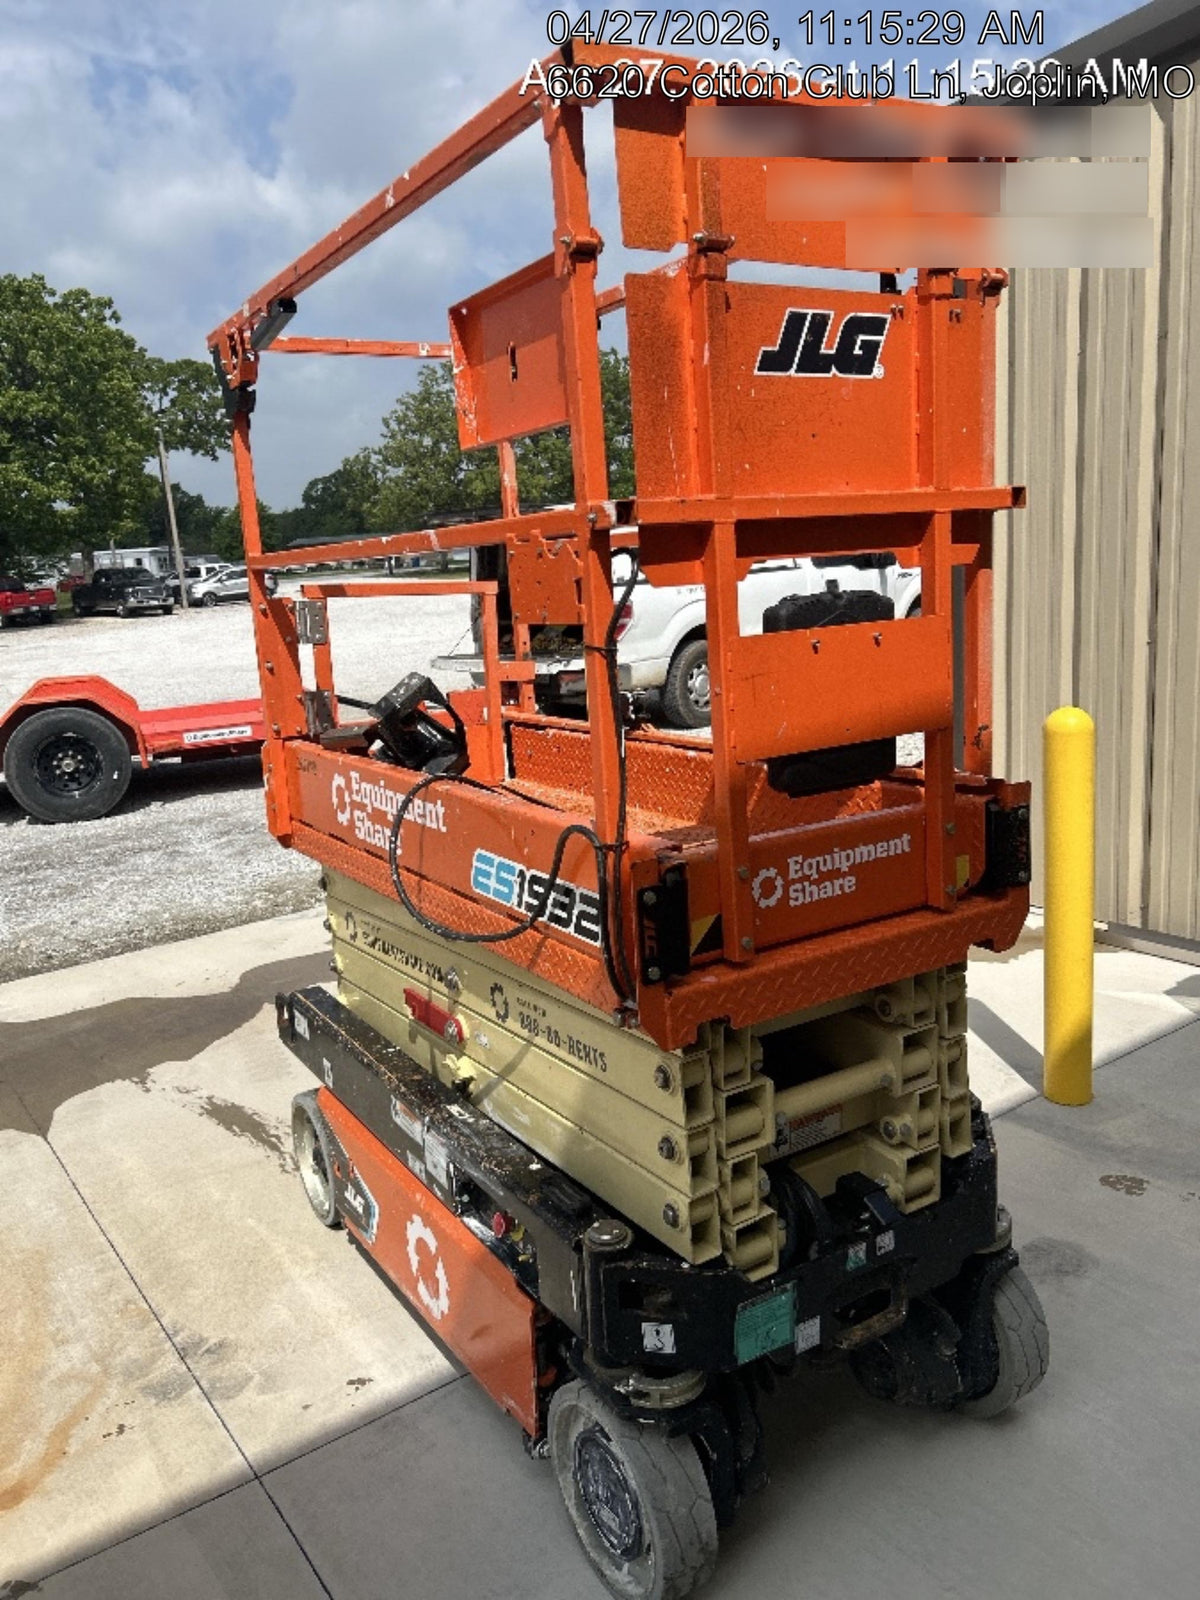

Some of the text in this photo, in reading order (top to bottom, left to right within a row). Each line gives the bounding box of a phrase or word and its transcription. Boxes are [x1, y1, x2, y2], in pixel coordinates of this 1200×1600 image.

[754, 307, 891, 379] JLG
[787, 833, 911, 880] Equipment
[788, 875, 857, 907] Share
